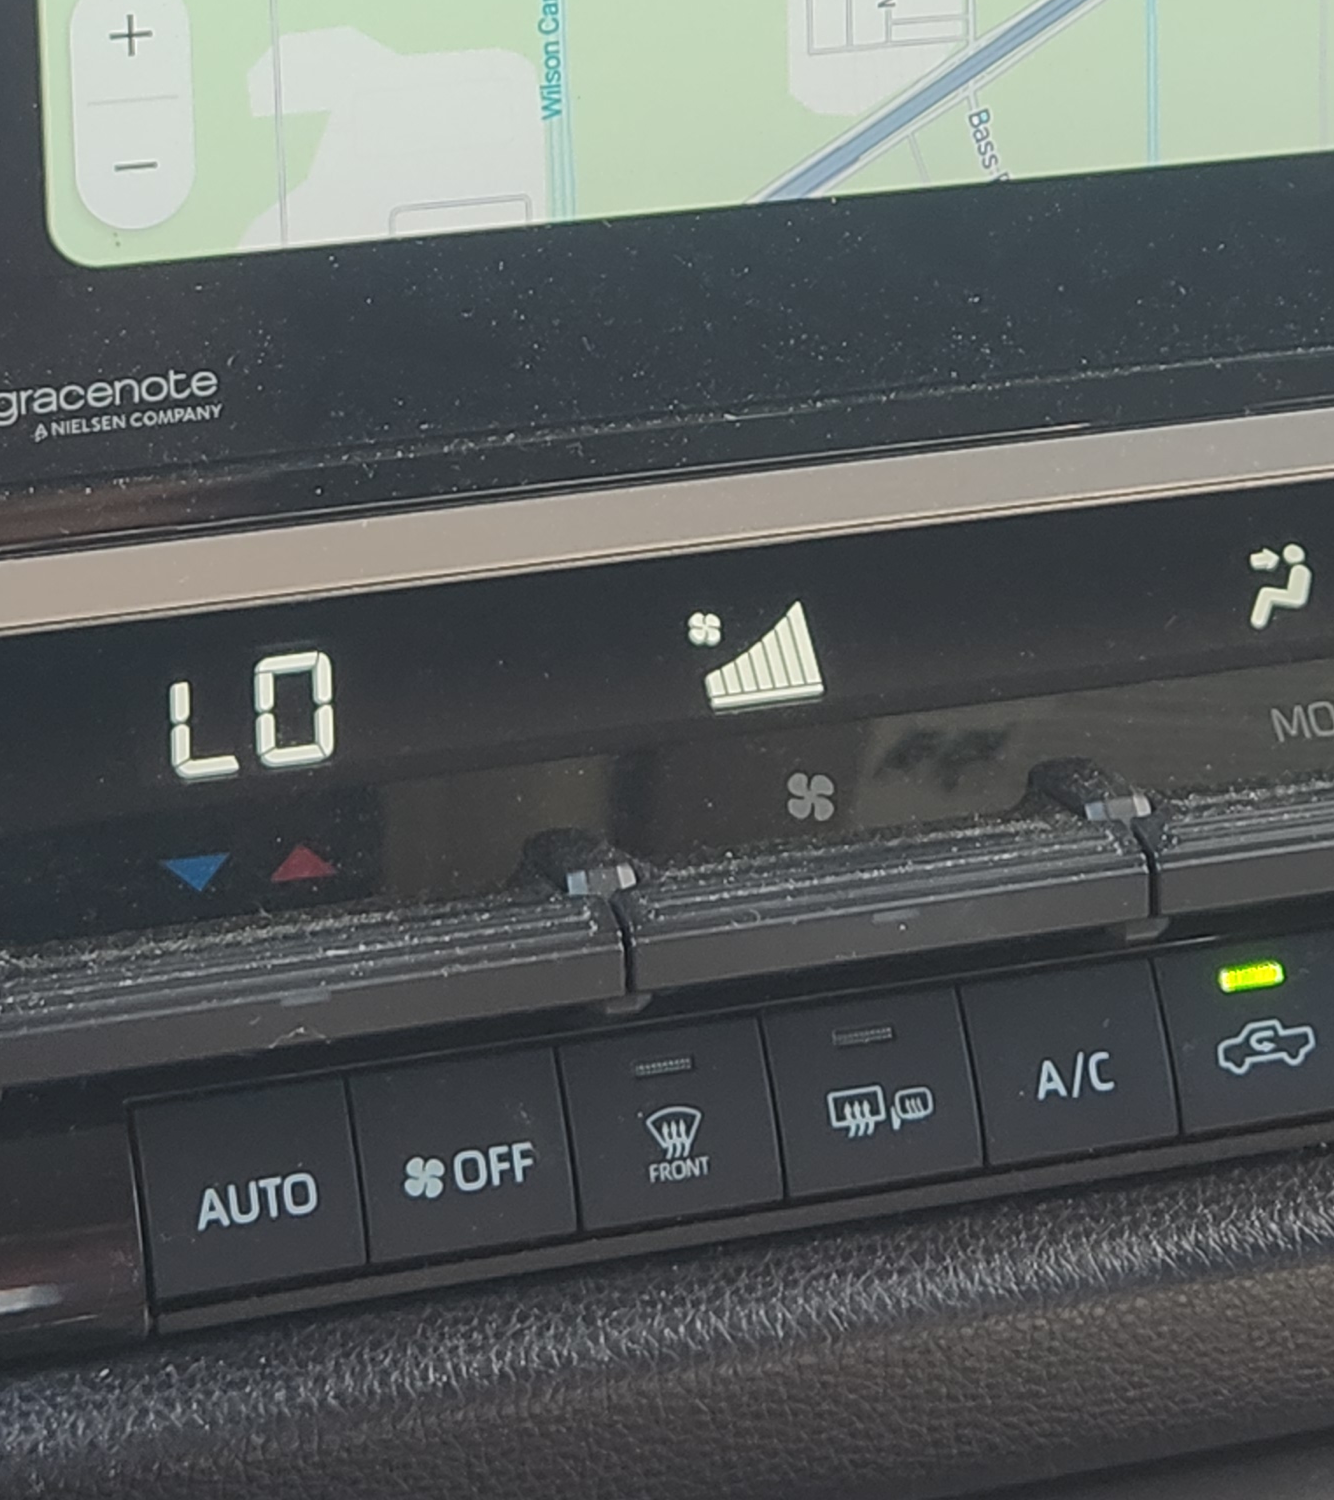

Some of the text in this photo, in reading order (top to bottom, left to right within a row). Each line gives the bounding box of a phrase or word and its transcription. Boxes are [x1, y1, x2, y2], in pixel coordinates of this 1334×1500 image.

[540, 40, 563, 120] Wilson
[969, 109, 998, 169] Bass
[33, 404, 222, 441] A NIELSEN COMPANY
[170, 651, 335, 779] LO
[1037, 1051, 1115, 1100] A/C
[453, 1142, 534, 1192] OFF
[649, 1155, 710, 1184] FRONT
[197, 1172, 318, 1231] AUTO
